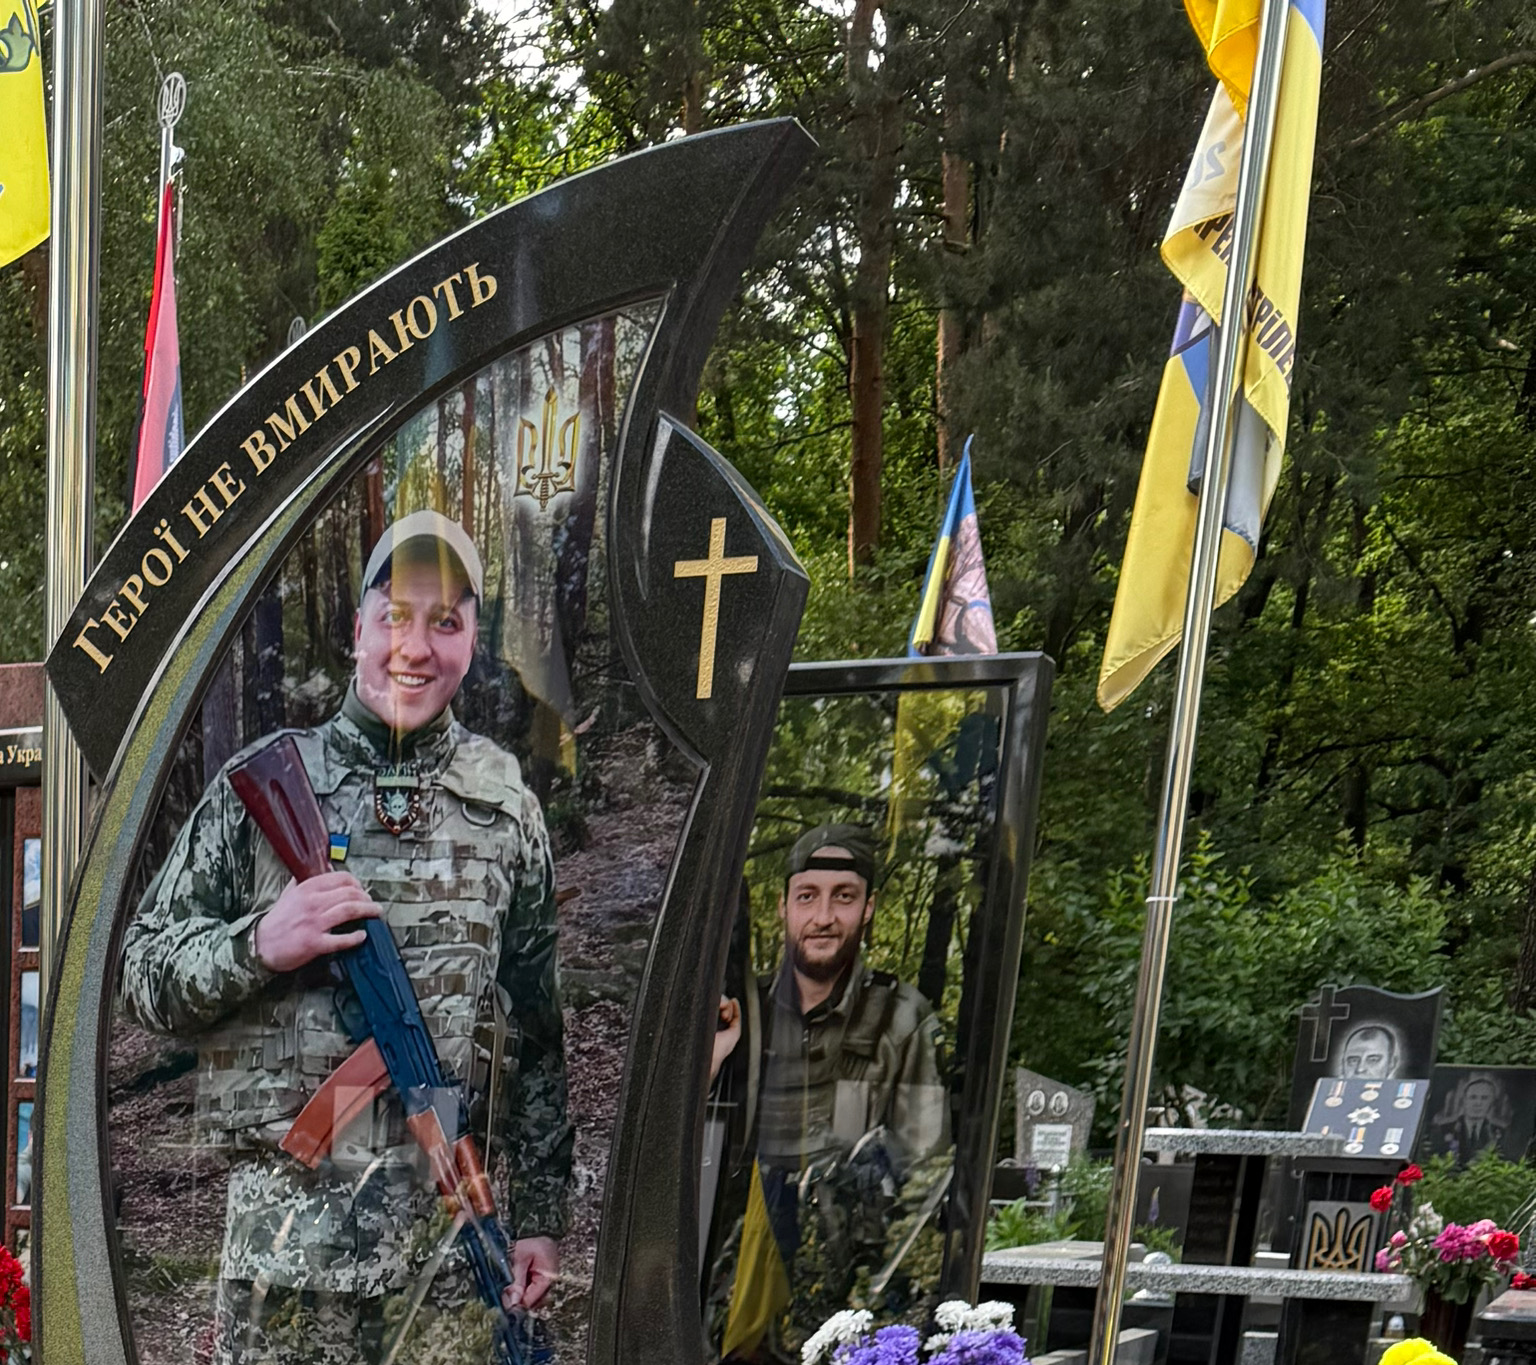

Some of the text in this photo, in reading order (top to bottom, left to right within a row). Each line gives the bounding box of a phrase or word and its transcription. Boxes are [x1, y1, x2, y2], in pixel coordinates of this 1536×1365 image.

[72, 261, 499, 675] ГЕРОЇ НЕ ВМИРАЮТЬ
